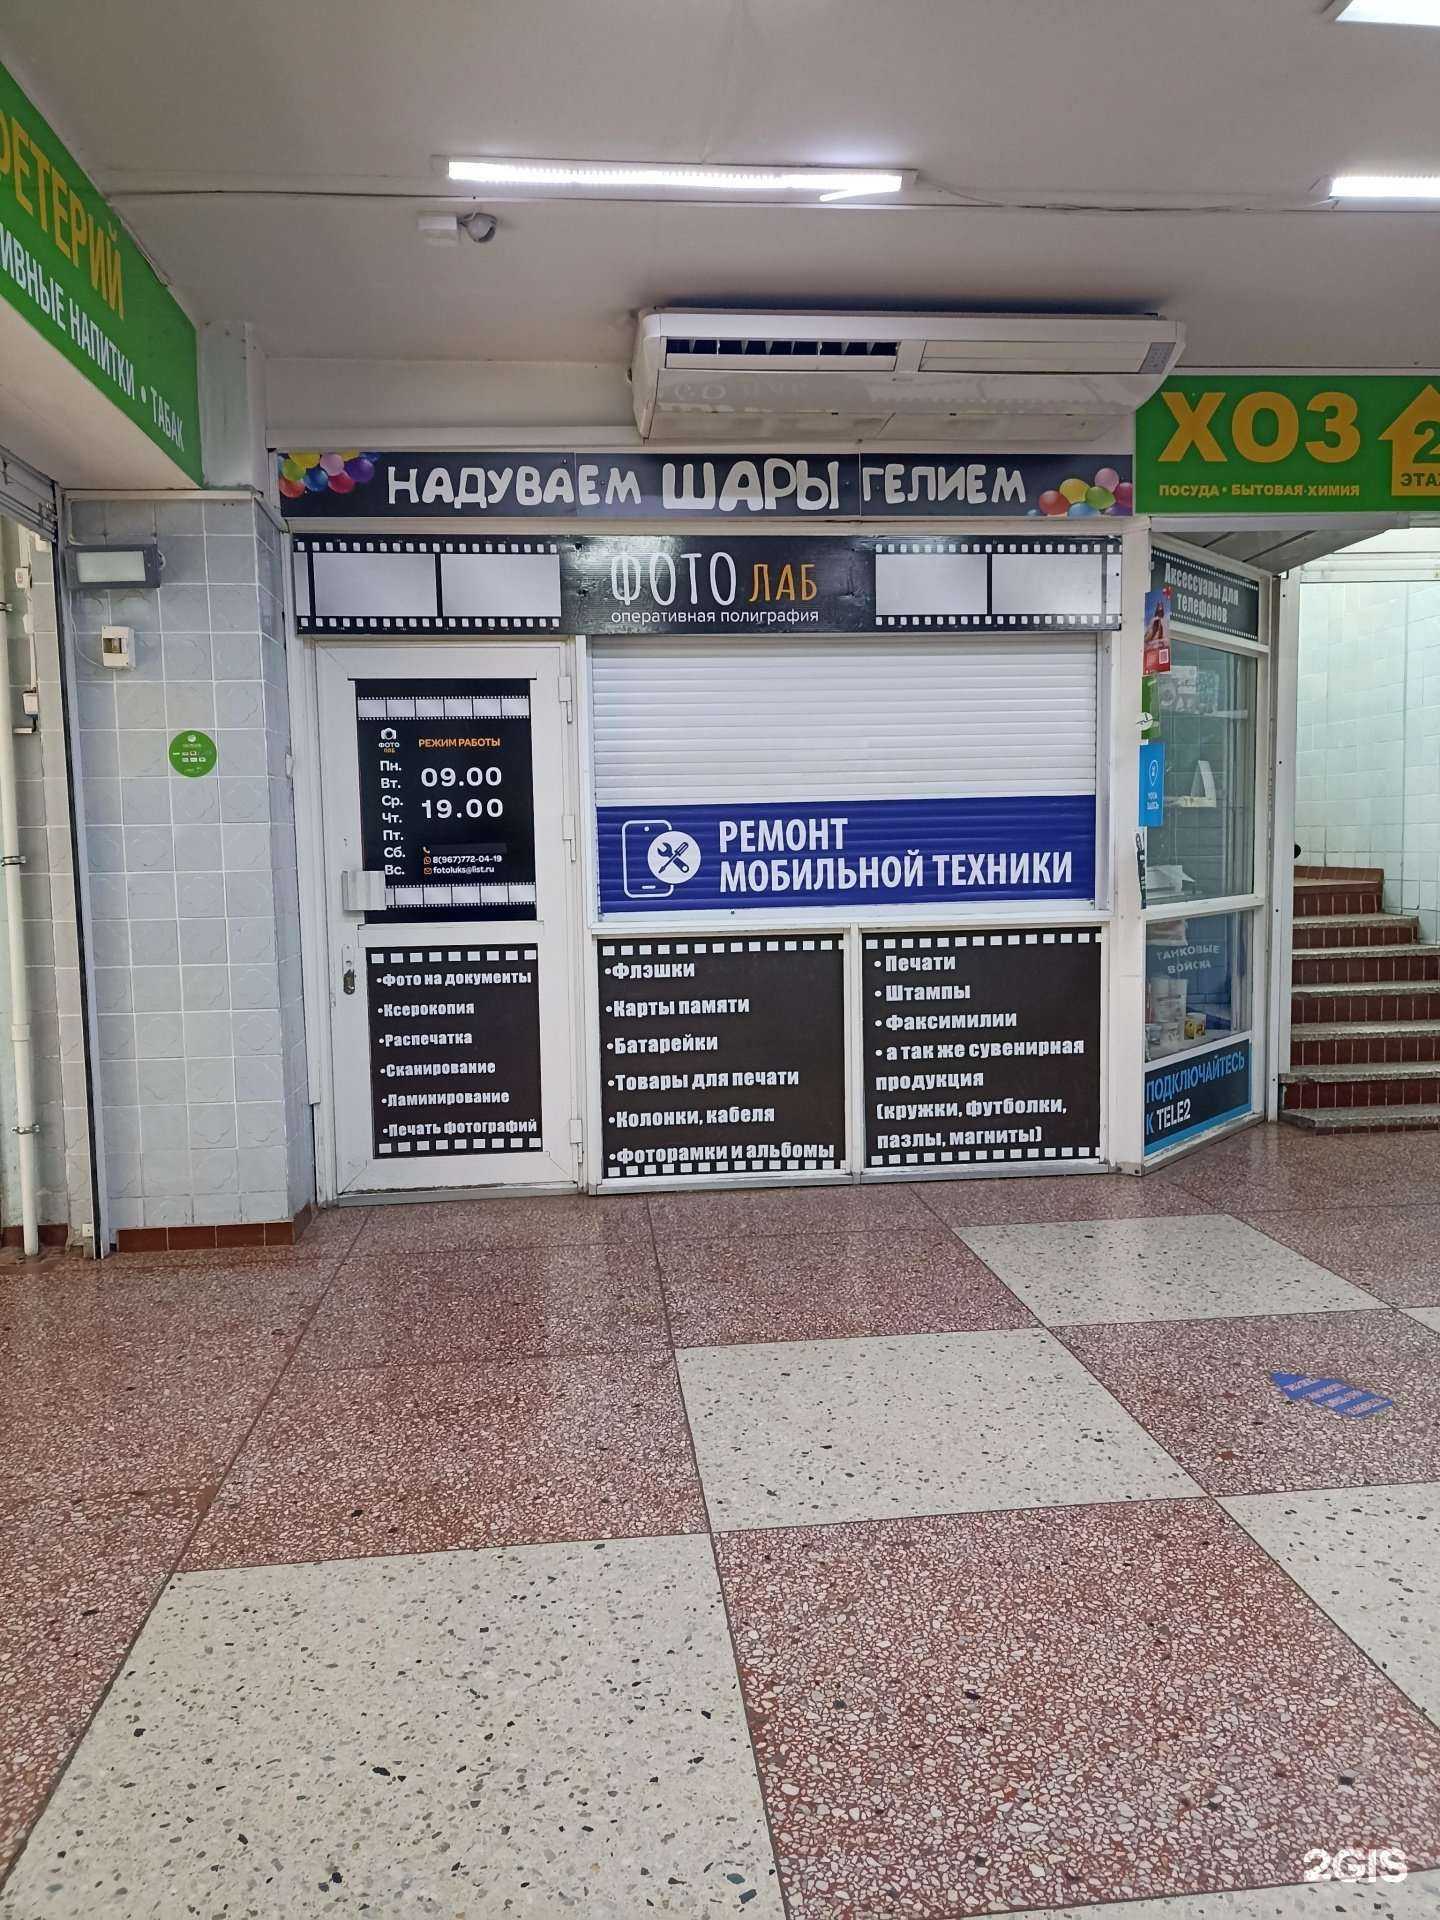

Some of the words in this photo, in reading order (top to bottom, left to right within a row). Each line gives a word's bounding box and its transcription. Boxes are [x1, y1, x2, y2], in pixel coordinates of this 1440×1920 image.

[69, 297, 135, 400] НАПИТКИ
[150, 385, 184, 452] ТАБАК
[1157, 391, 1361, 463] ХОЗ
[1413, 420, 1440, 463] 2
[387, 465, 642, 509] НАДУВАЕМ
[662, 458, 839, 512] ШАРЫ
[862, 464, 1027, 505] ГЕЛИЕМ
[1400, 472, 1440, 487] ЭТА
[1159, 484, 1220, 498] ПОСУДА
[1231, 484, 1303, 496] БЫТОВАЯ
[1308, 484, 1360, 497] ХИМИЯ
[611, 551, 737, 606] ФОТО
[748, 563, 818, 602] ЛАБ
[1164, 562, 1221, 600] Аксессуары
[1221, 585, 1239, 606] для
[611, 611, 716, 625] оперативная
[720, 608, 819, 626] полиграфия
[1176, 593, 1228, 624] телефонов
[418, 739, 457, 748] РЕЖИМ
[458, 738, 501, 747] РАБОТЫ
[380, 761, 402, 772] Пн.
[380, 778, 402, 789] Вт.
[421, 767, 502, 787] 09.00
[381, 795, 404, 808] Ср.
[421, 799, 504, 819] 19.00
[382, 812, 403, 823] Чт.
[383, 830, 404, 841] Пт.
[719, 818, 848, 853] РЕМОНТ
[384, 846, 406, 858] Сб.
[384, 864, 405, 876] Вс.
[433, 865, 495, 875] fotoluks@list.ru
[719, 849, 924, 893] МОБИЛЬНОЙ
[932, 851, 1073, 887] ТЕХНИКИ
[612, 963, 695, 979] Флэшки
[885, 955, 956, 972] Печати
[382, 974, 422, 986] Фото
[424, 975, 443, 985] на
[444, 972, 532, 986] документы
[885, 985, 971, 1001] Штампы
[383, 1003, 475, 1017] Ксерокопия
[613, 1000, 675, 1017] Карты
[678, 998, 750, 1014] памяти
[885, 1013, 1017, 1031] Факсимилии
[385, 1033, 473, 1047] Распечатка
[614, 1033, 718, 1054] Батарейки
[886, 1046, 898, 1061] а
[900, 1044, 934, 1060] так
[937, 1042, 965, 1058] же
[968, 1040, 1085, 1059] сувенирная
[386, 1062, 496, 1077] Сканирование
[1146, 1050, 1245, 1104] ПОДКЛЮЧАЙТЕСЬ
[615, 1074, 689, 1091] Товары
[691, 1073, 729, 1089] для
[732, 1071, 799, 1086] печати
[875, 1073, 984, 1091] продукция
[387, 1092, 510, 1107] Ламинирование
[616, 1110, 703, 1128] Колонки,
[706, 1107, 775, 1124] кабеля
[876, 1104, 963, 1121] (кружки,
[965, 1098, 1067, 1119] футболки,
[1146, 1113, 1154, 1136] К
[1156, 1098, 1191, 1132] TELE2
[388, 1124, 441, 1137] Печать
[443, 1118, 537, 1134] фотографий
[877, 1133, 946, 1149] пазлы,
[949, 1126, 1042, 1146] магниты)
[730, 1145, 743, 1158] и
[746, 1141, 834, 1159] альбомы
